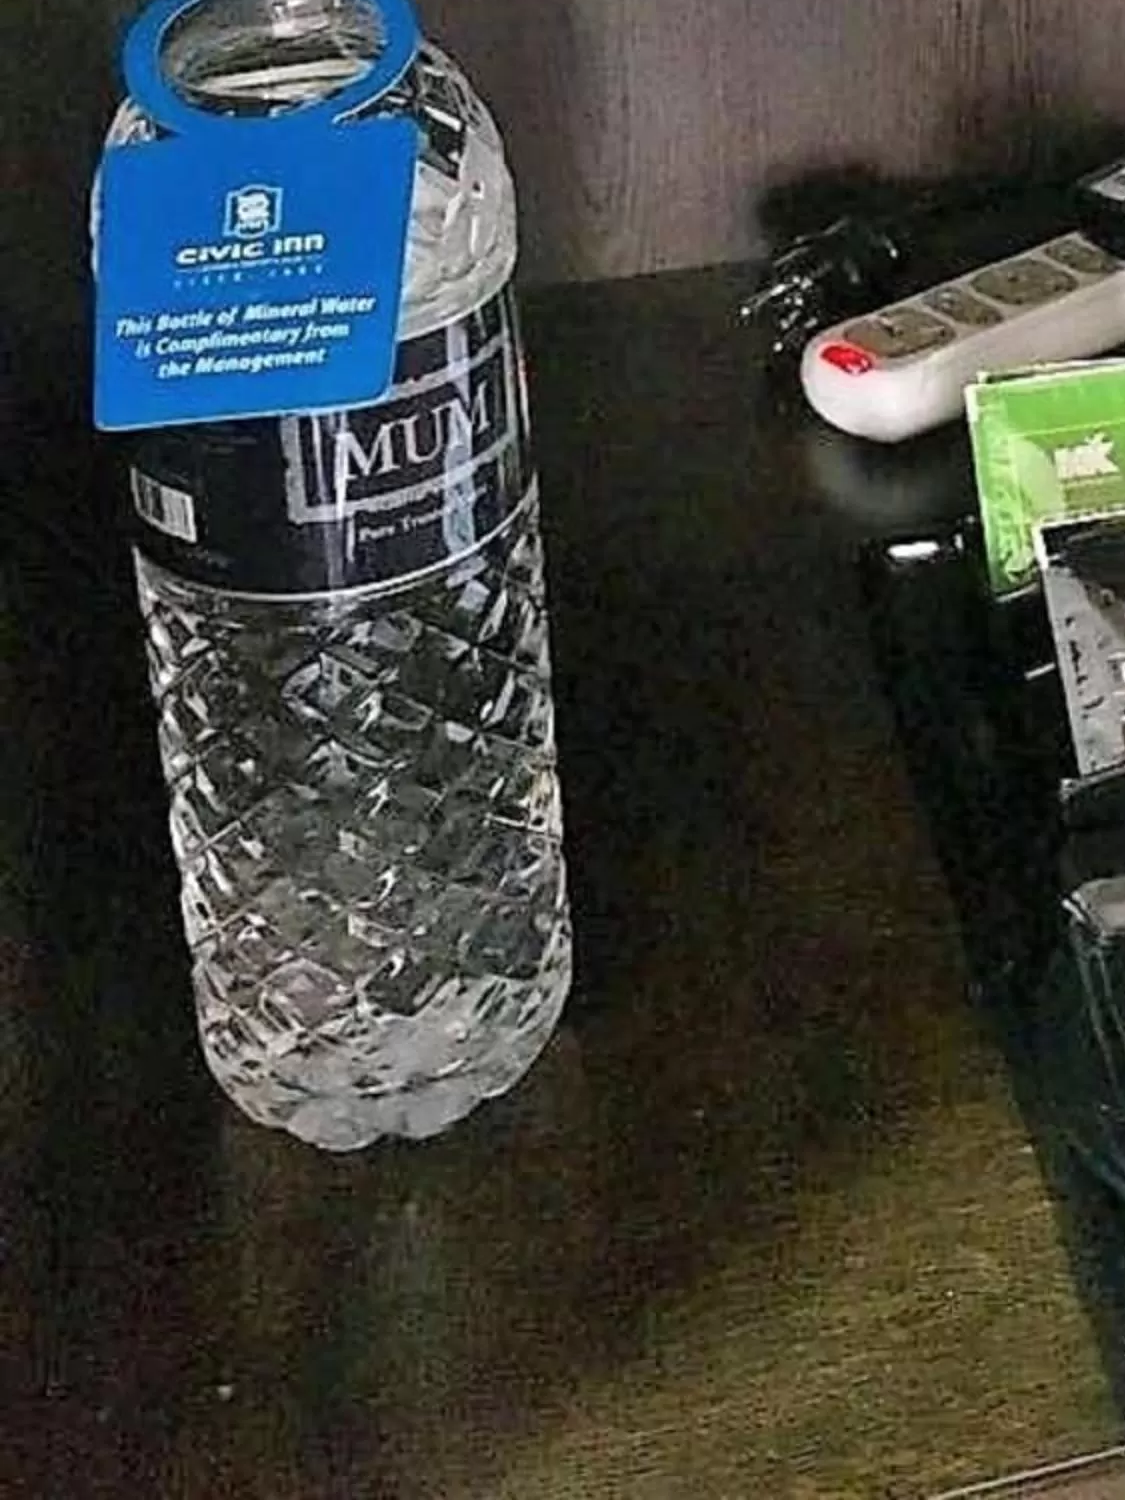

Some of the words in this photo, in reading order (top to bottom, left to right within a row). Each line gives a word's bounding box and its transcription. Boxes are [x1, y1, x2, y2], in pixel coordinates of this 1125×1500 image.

[116, 316, 151, 338] This
[156, 308, 213, 333] Bottle
[216, 305, 239, 328] of
[243, 297, 318, 323] Mineral
[319, 295, 378, 317] Water
[154, 320, 303, 357] Complimentary
[303, 318, 351, 343] from
[157, 359, 193, 380] the
[194, 346, 329, 374] Management
